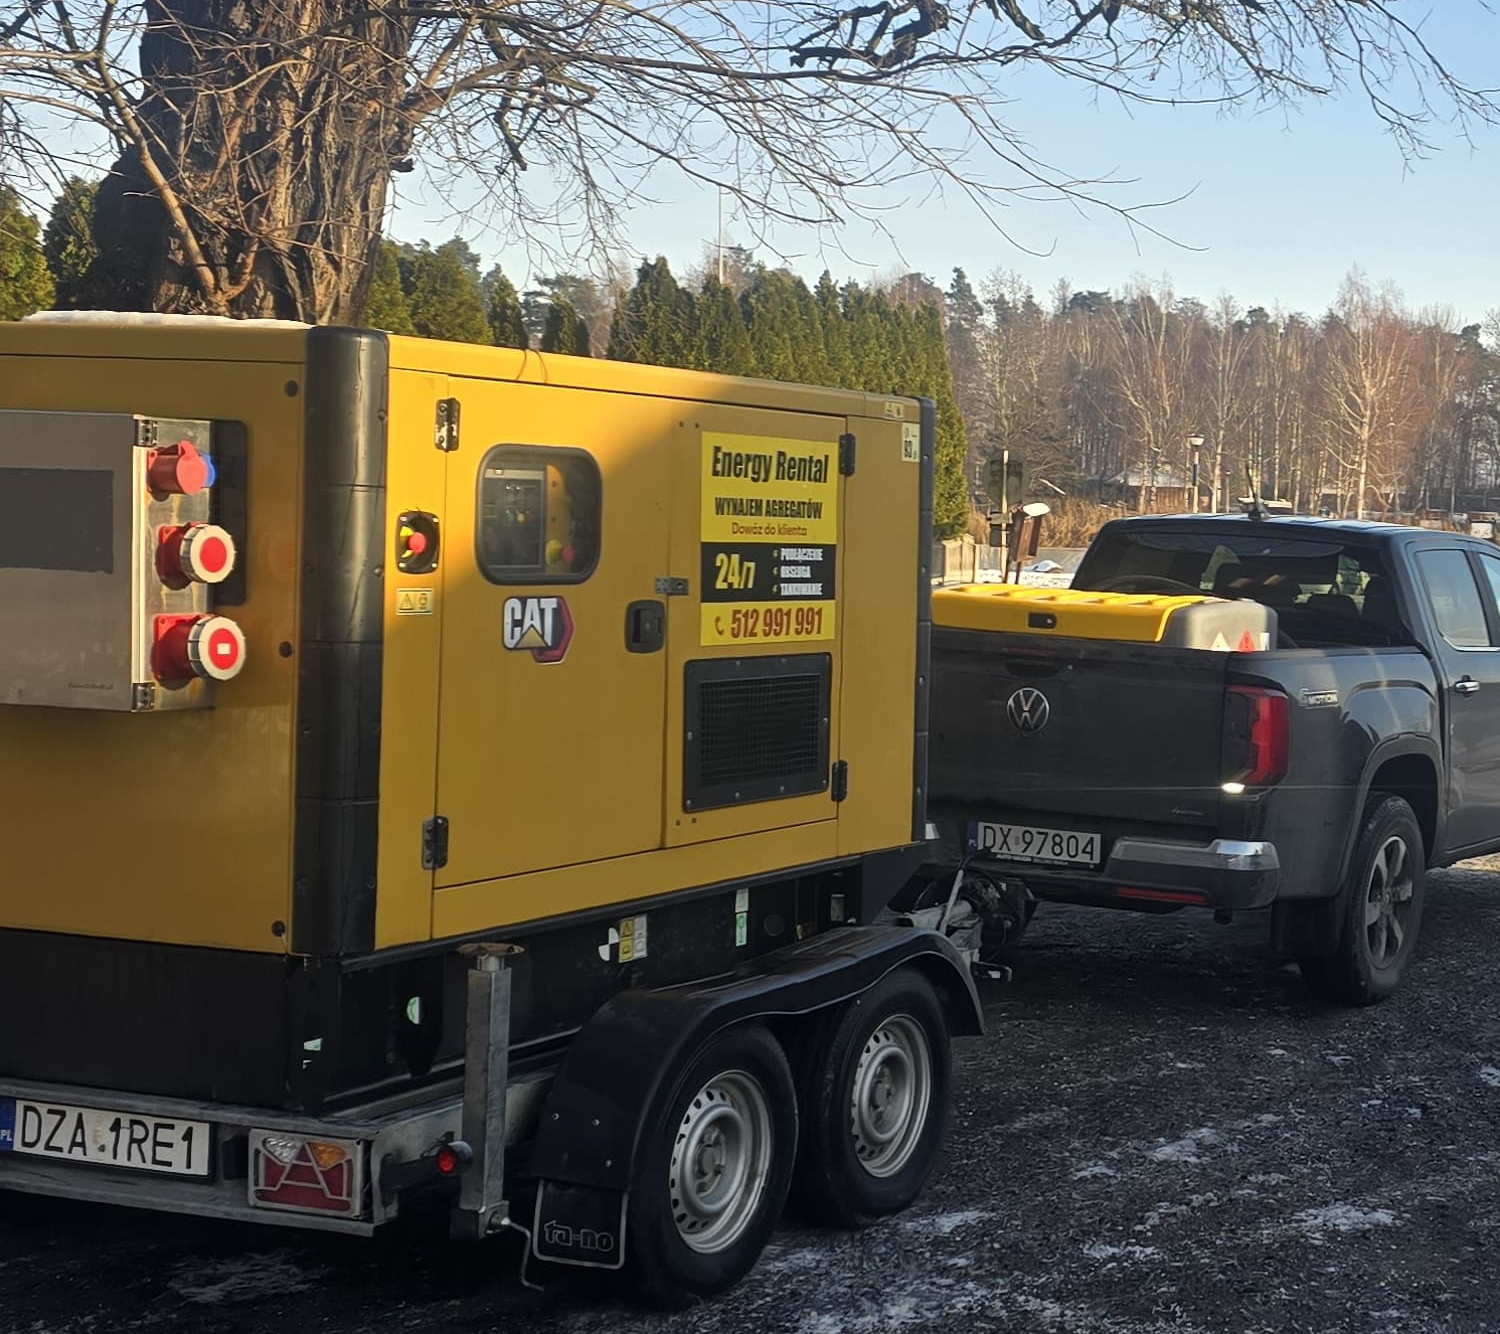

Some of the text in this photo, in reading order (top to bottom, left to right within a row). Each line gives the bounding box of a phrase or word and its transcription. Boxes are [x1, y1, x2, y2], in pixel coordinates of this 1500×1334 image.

[712, 445, 830, 483] Energy Rental
[714, 496, 823, 519] WYNAJEM AGREGATÓW
[731, 522, 807, 536] Dowóz do klienta
[715, 553, 756, 589] 24/7
[503, 597, 558, 649] CAT
[731, 607, 823, 638] 512 991 991
[983, 825, 1012, 852] DX
[1021, 829, 1095, 862] 97804
[1, 1129, 13, 1142] PL
[21, 1105, 194, 1169] DZA 1RE1
